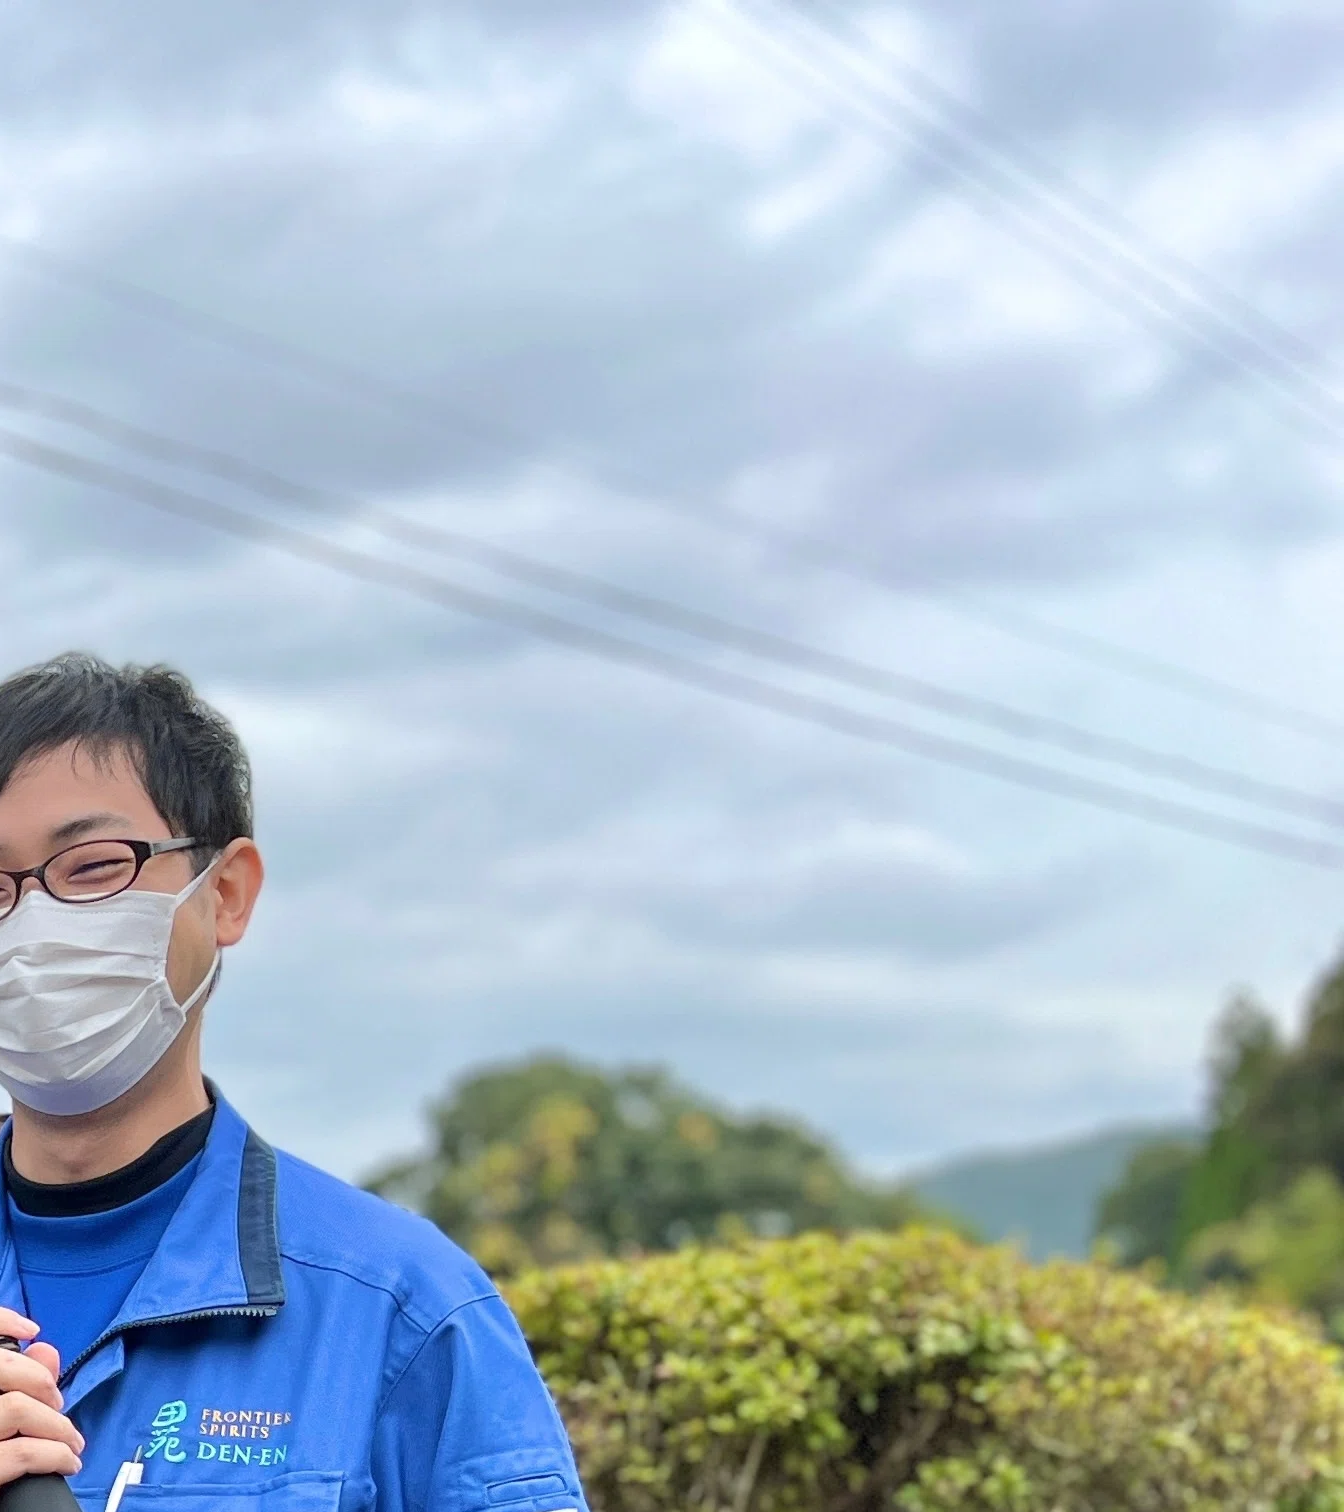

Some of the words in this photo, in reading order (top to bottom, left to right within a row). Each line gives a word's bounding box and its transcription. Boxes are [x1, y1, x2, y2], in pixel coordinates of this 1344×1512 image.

[144, 1400, 187, 1463] 田苑
[199, 1422, 270, 1439] SPIRITS
[196, 1441, 288, 1466] DEN-EN
